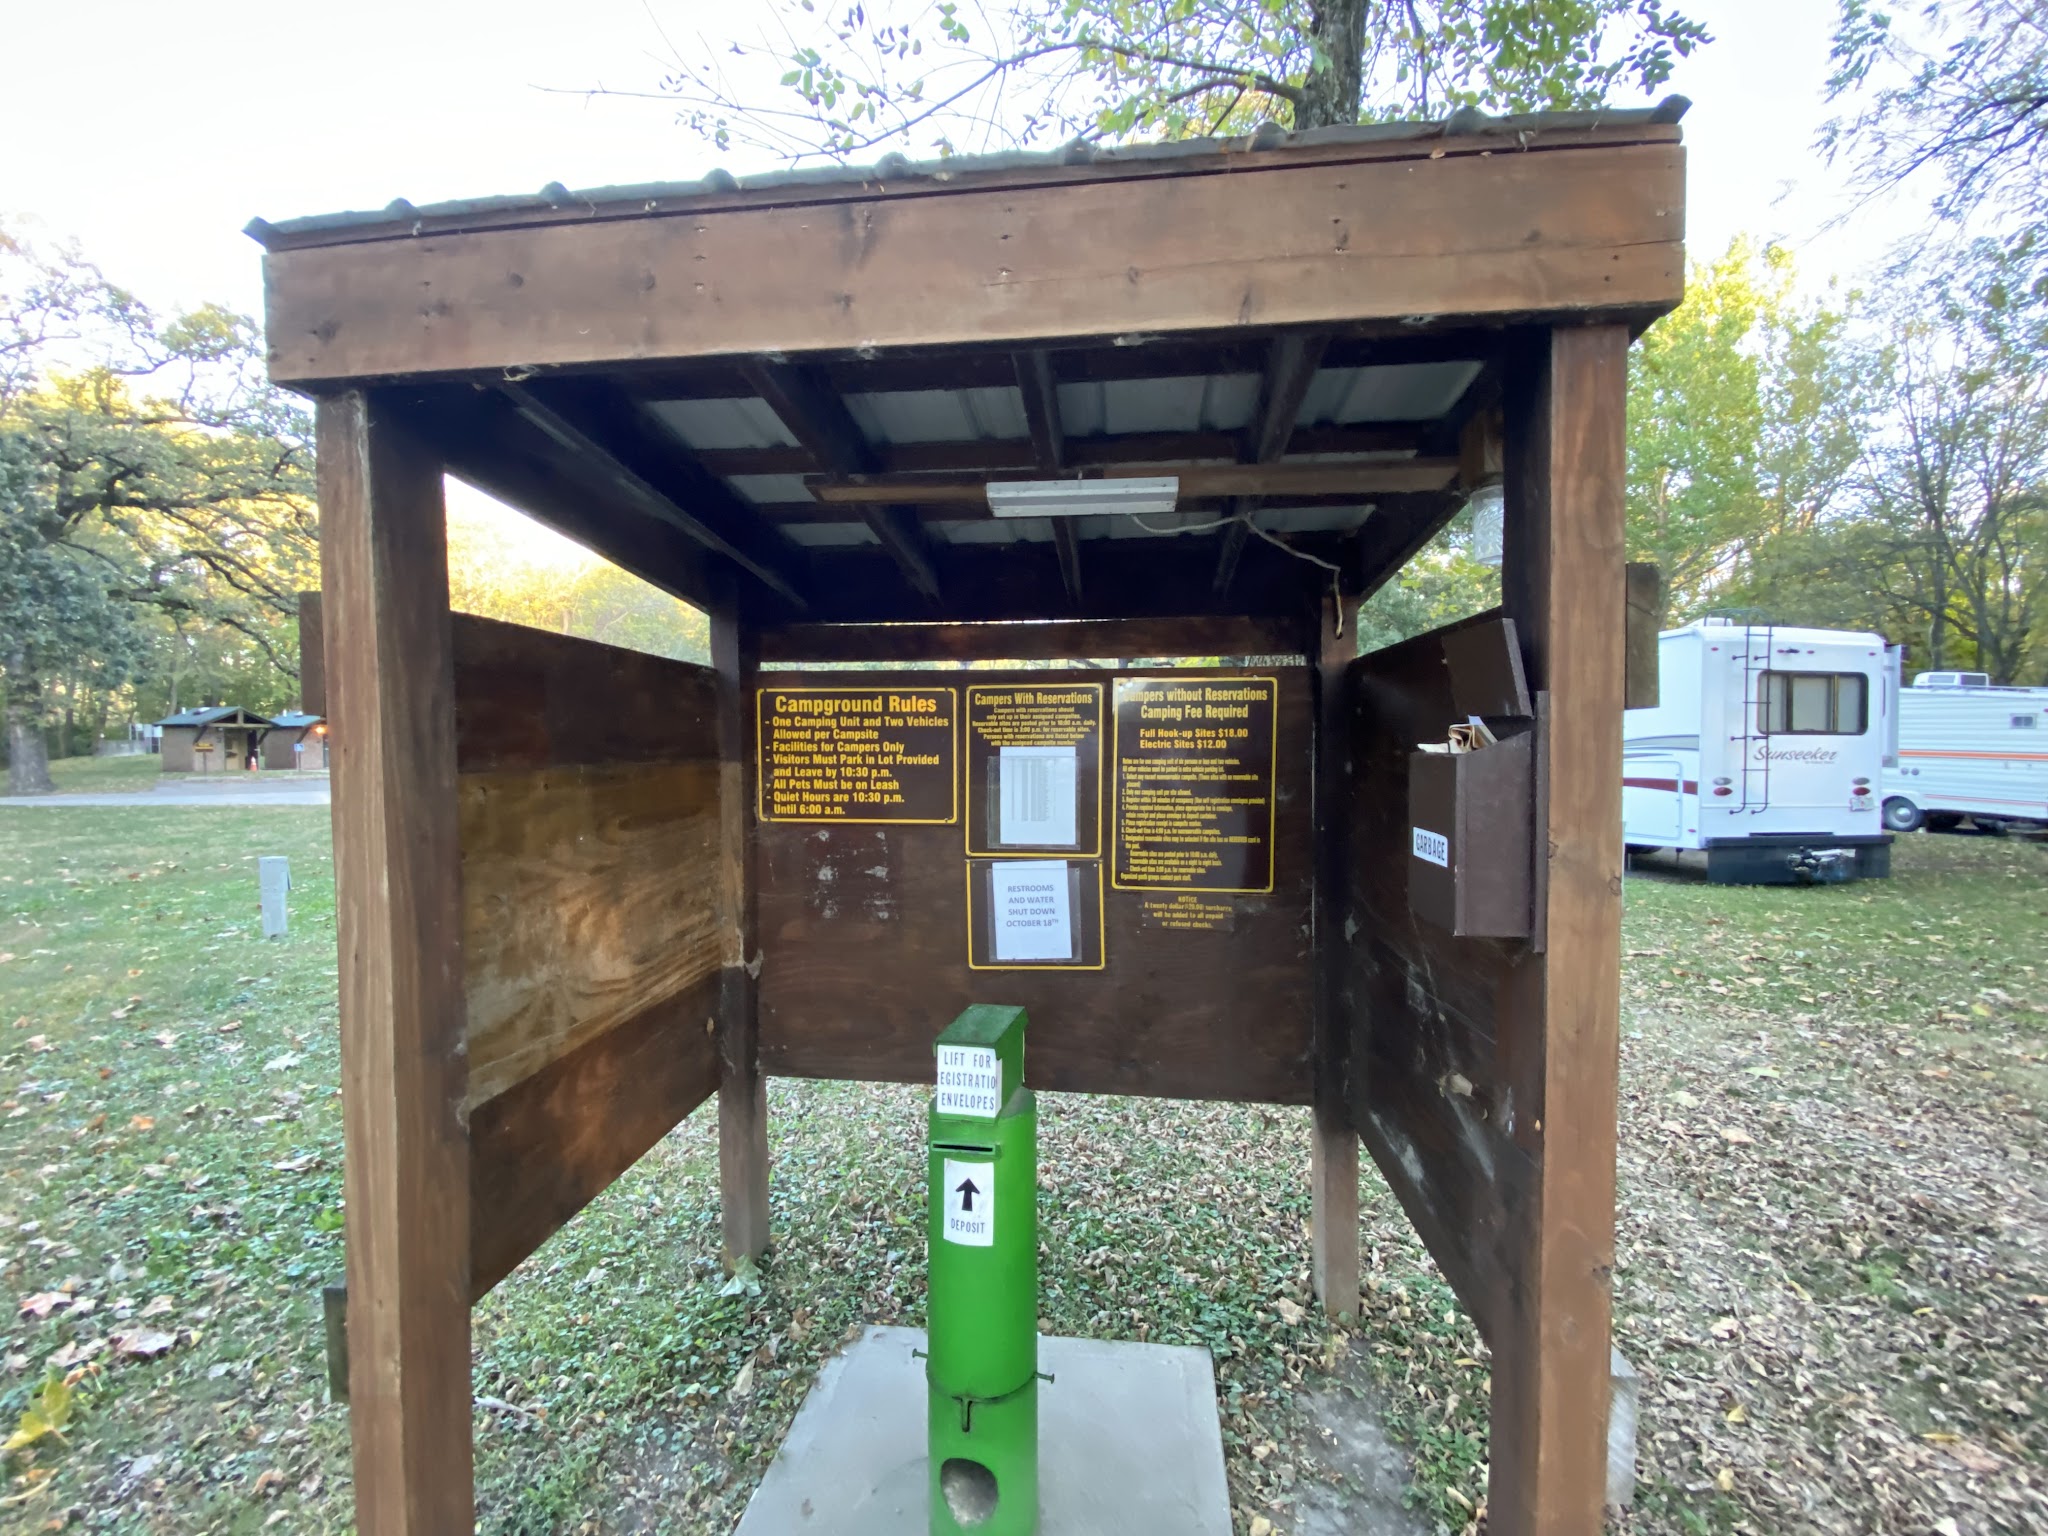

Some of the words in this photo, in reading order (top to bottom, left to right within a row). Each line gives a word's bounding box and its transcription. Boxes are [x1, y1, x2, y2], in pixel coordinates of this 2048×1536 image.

[975, 693, 1012, 706] Campers
[1014, 692, 1034, 704] With
[1037, 692, 1092, 704] Reservations
[1167, 688, 1202, 701] without
[1206, 688, 1267, 701] Reservations
[775, 696, 882, 716] Campground
[889, 696, 936, 712] Rules
[1141, 705, 1182, 721] Camping
[1185, 705, 1202, 718] Fee
[1205, 704, 1248, 720] Required
[773, 717, 791, 726] One
[794, 717, 836, 728] Camping
[840, 717, 860, 726] Unit
[863, 717, 881, 726] and
[884, 717, 903, 726] Two
[907, 717, 949, 726] Vehicles
[773, 729, 811, 739] Allowed
[814, 731, 830, 741] per
[833, 729, 879, 741] Campsite
[1140, 729, 1155, 737] Full
[1158, 729, 1192, 739] Hook-up
[1195, 729, 1215, 737] Sites
[1218, 728, 1248, 738] $18.00
[773, 742, 817, 751] Facilities
[821, 742, 834, 751] for
[837, 742, 879, 754] Campers
[883, 742, 904, 754] Only
[1140, 740, 1171, 748] Electric
[1174, 740, 1194, 748] Sites
[1197, 740, 1226, 749] $12.00
[1754, 746, 1837, 760] Sunseeker
[773, 755, 809, 764] Visitors
[813, 755, 837, 764] Must
[840, 755, 862, 764] Park
[866, 755, 874, 764] in
[878, 755, 893, 764] Lot
[896, 755, 939, 764] Provided
[774, 767, 791, 777] and
[795, 767, 822, 777] Leave
[826, 767, 837, 779] by
[840, 767, 868, 777] 10:30
[871, 769, 892, 779] p.m.
[773, 780, 786, 789] All
[790, 780, 810, 789] Pets
[814, 780, 837, 789] Must
[841, 780, 852, 789] be
[856, 780, 867, 789] on
[871, 780, 899, 789] Leash
[774, 792, 799, 803] Quiet
[802, 792, 830, 802] Hours
[833, 794, 849, 802] are
[853, 792, 880, 802] 10:30
[884, 794, 904, 804] p.m.
[774, 804, 796, 814] Until
[800, 804, 821, 814] 6:00
[825, 806, 845, 814] a.m.
[1416, 833, 1444, 861] GARBAGE
[1044, 919, 1058, 927] 18TH
[944, 1052, 965, 1065] LIFT
[974, 1054, 991, 1068] FOR
[940, 1072, 997, 1089] EGISTRATIO
[941, 1093, 994, 1110] ENVELOPES
[951, 1218, 985, 1234] DEPOSIT
